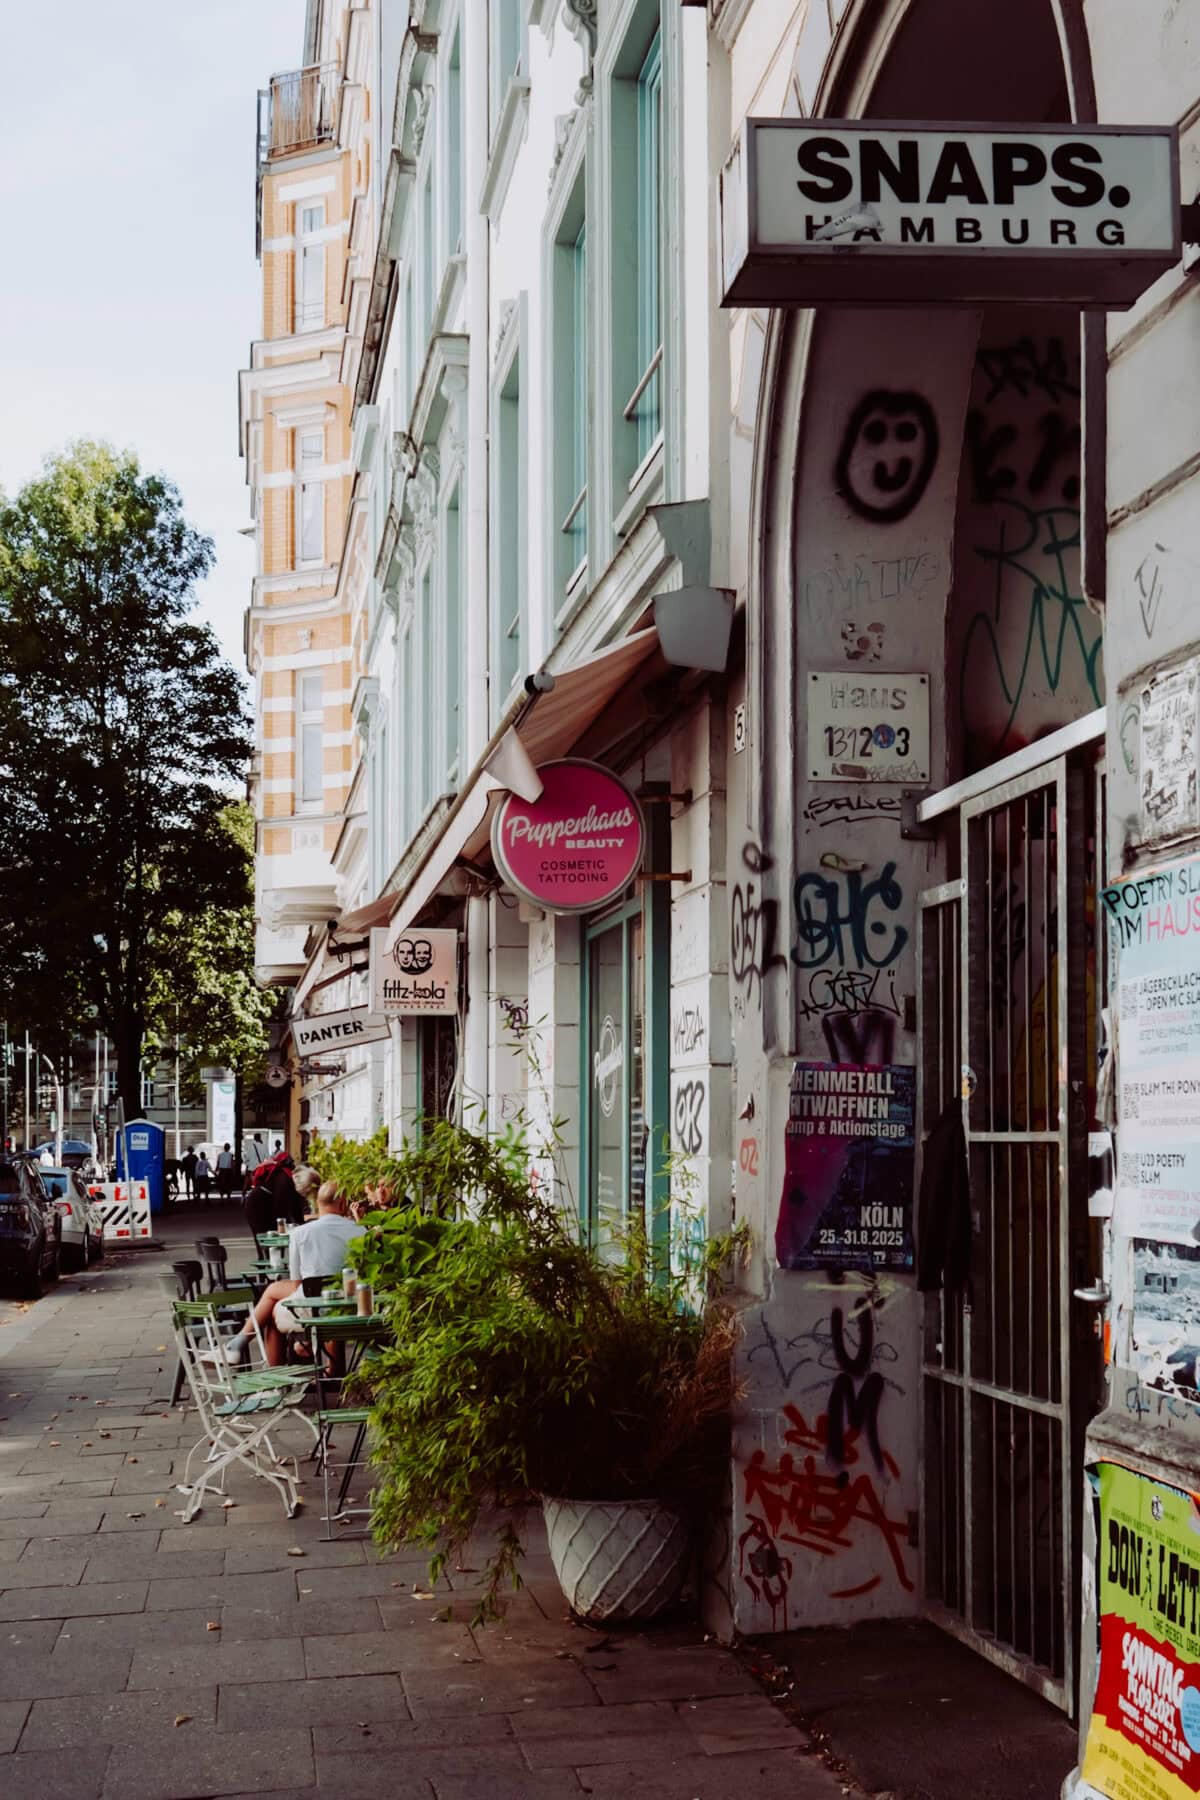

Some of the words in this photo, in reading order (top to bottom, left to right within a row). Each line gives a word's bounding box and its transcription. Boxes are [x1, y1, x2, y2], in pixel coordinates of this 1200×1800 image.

[797, 137, 1131, 208] SNAPS.
[805, 215, 1125, 245] HAMBURG
[830, 683, 907, 710] Haus
[506, 804, 635, 848] Puppenhaus
[564, 838, 624, 849] BEAUTY
[538, 872, 609, 884] TATTOOING
[540, 859, 606, 871] COSMETIC
[1103, 871, 1174, 914] POETRY
[1116, 914, 1143, 949] IM
[299, 1020, 364, 1045] PANTER
[829, 1119, 906, 1138] Aktionstage
[860, 1202, 904, 1228] KÖLN
[1108, 1519, 1143, 1596] DON
[1121, 1632, 1185, 1709] SONNTAG
